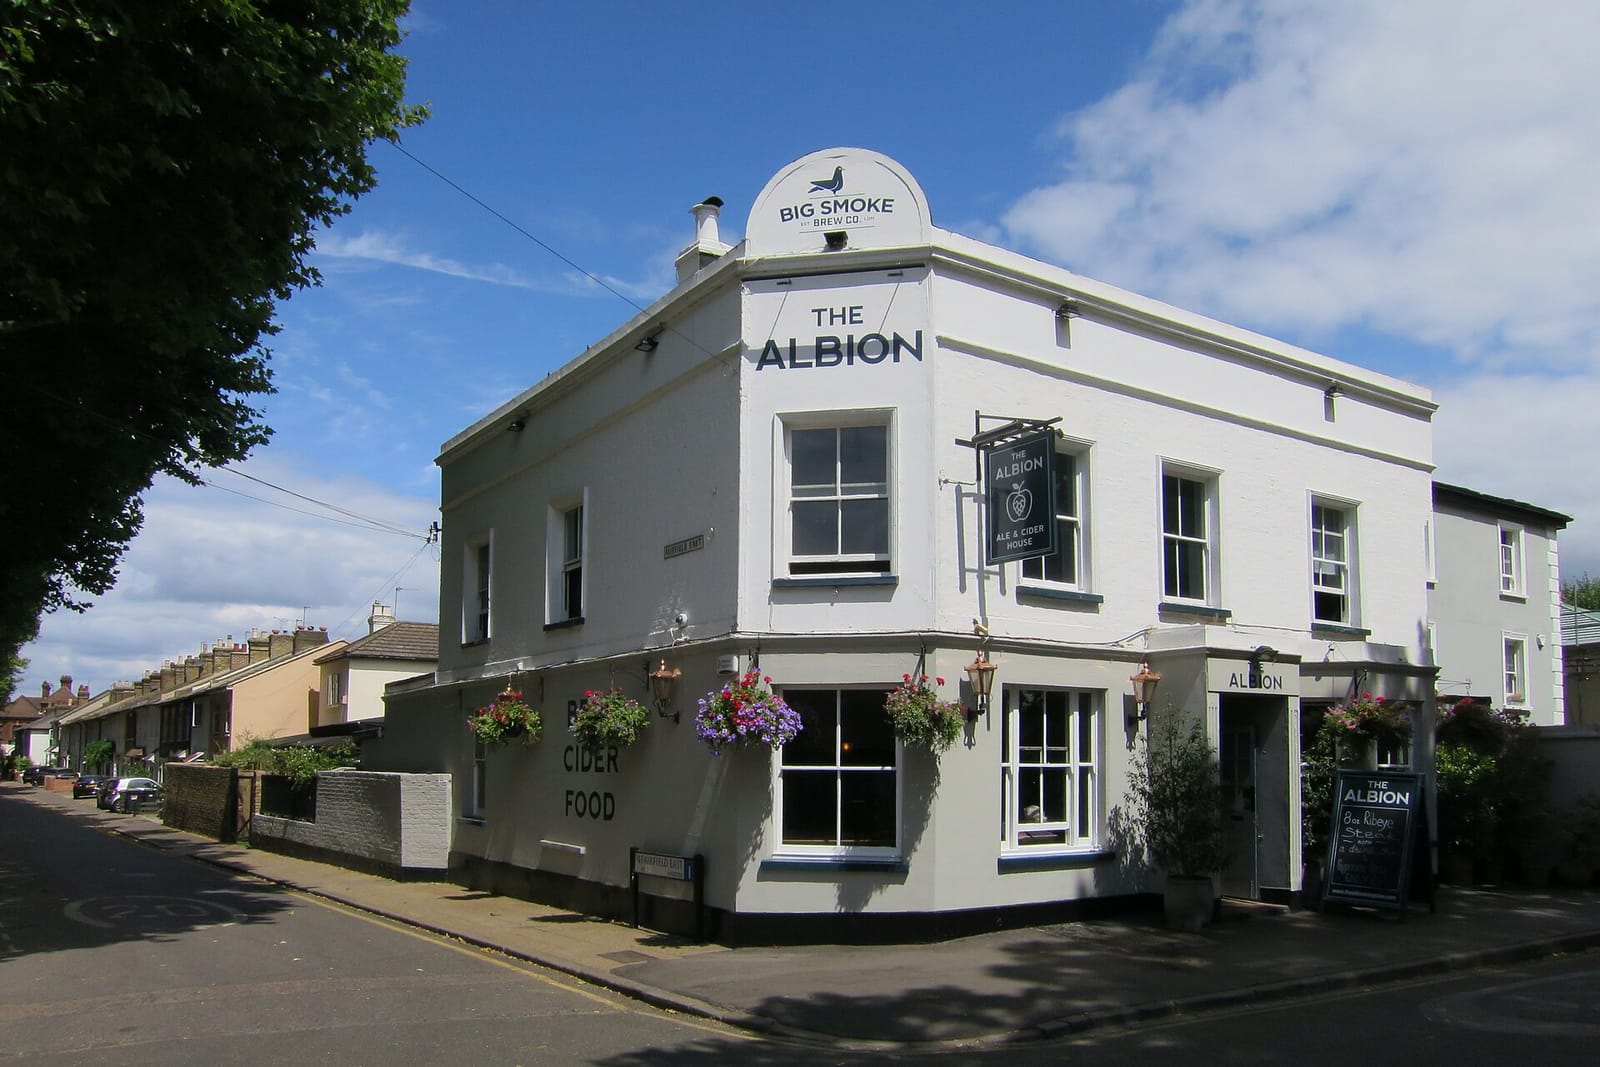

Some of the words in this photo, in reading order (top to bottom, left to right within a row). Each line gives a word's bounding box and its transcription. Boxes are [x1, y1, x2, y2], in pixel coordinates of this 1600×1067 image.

[779, 203, 815, 223] BIG
[821, 198, 895, 215] SMOKE
[813, 216, 843, 227] BREW
[845, 215, 861, 225] CO.
[811, 305, 863, 327] THE
[755, 329, 923, 371] ALBION
[1011, 449, 1026, 460] THE
[995, 455, 1043, 481] ALBION
[996, 531, 1011, 542] ALE
[1013, 529, 1018, 538] &
[1021, 524, 1045, 537] CIDER
[1006, 537, 1033, 550] HOUSE
[1229, 672, 1282, 690] ALBION
[563, 744, 619, 774] CIDER
[1367, 780, 1389, 790] THE
[565, 789, 616, 822] FOOD
[1344, 788, 1410, 805] ALBION
[1363, 810, 1394, 832] Ribeye
[669, 859, 683, 870] EAST
